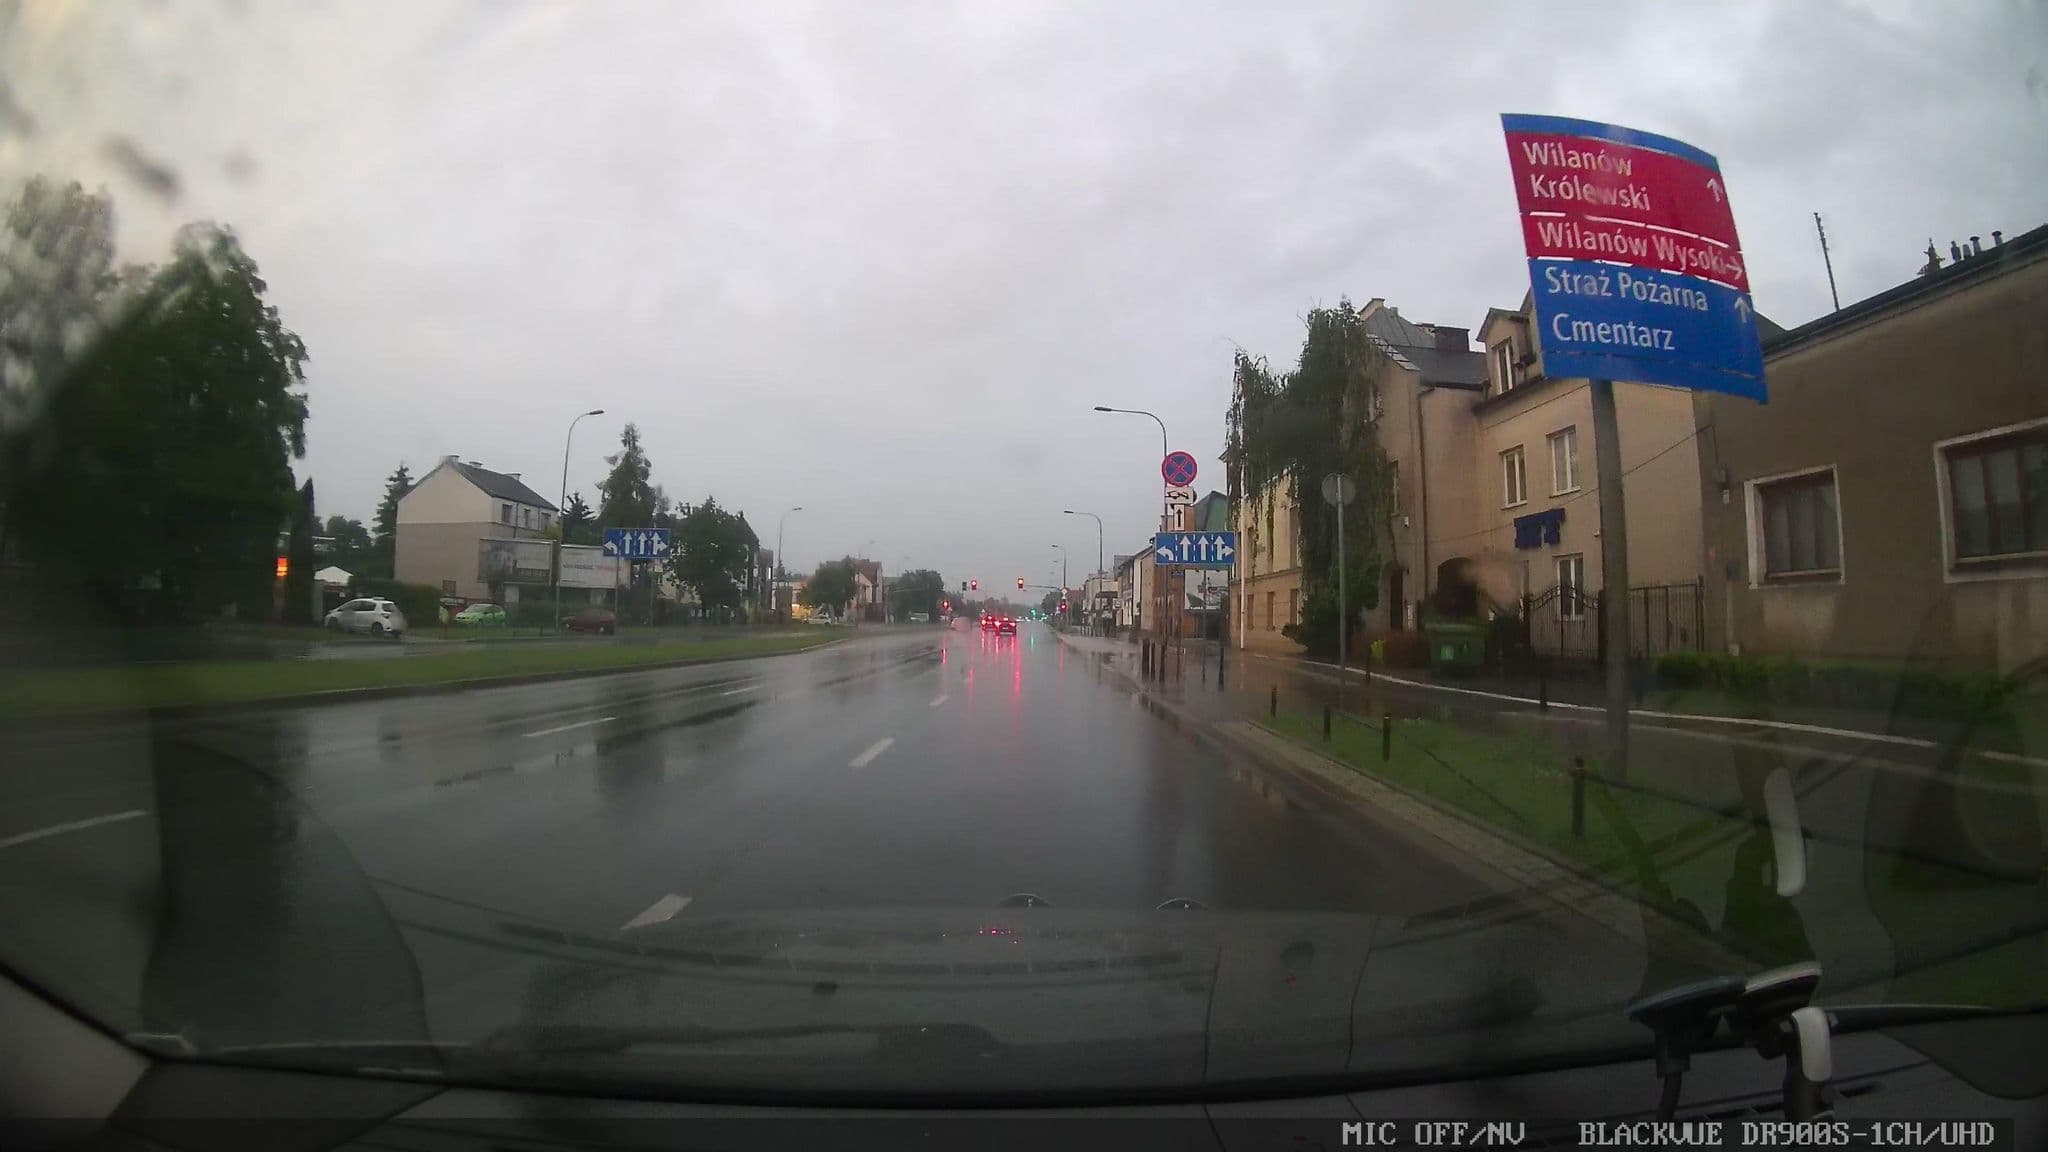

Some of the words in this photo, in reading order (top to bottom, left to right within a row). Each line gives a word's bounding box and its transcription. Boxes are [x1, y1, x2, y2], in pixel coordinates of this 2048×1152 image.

[1522, 141, 1632, 176] Wilanów
[1530, 173, 1651, 211] Królewski
[1538, 221, 1648, 257] Wilanów
[1651, 234, 1727, 274] Wysoki
[1545, 266, 1613, 297] Straż
[1618, 271, 1709, 312] Pożarna
[1552, 313, 1676, 350] Cmentarz
